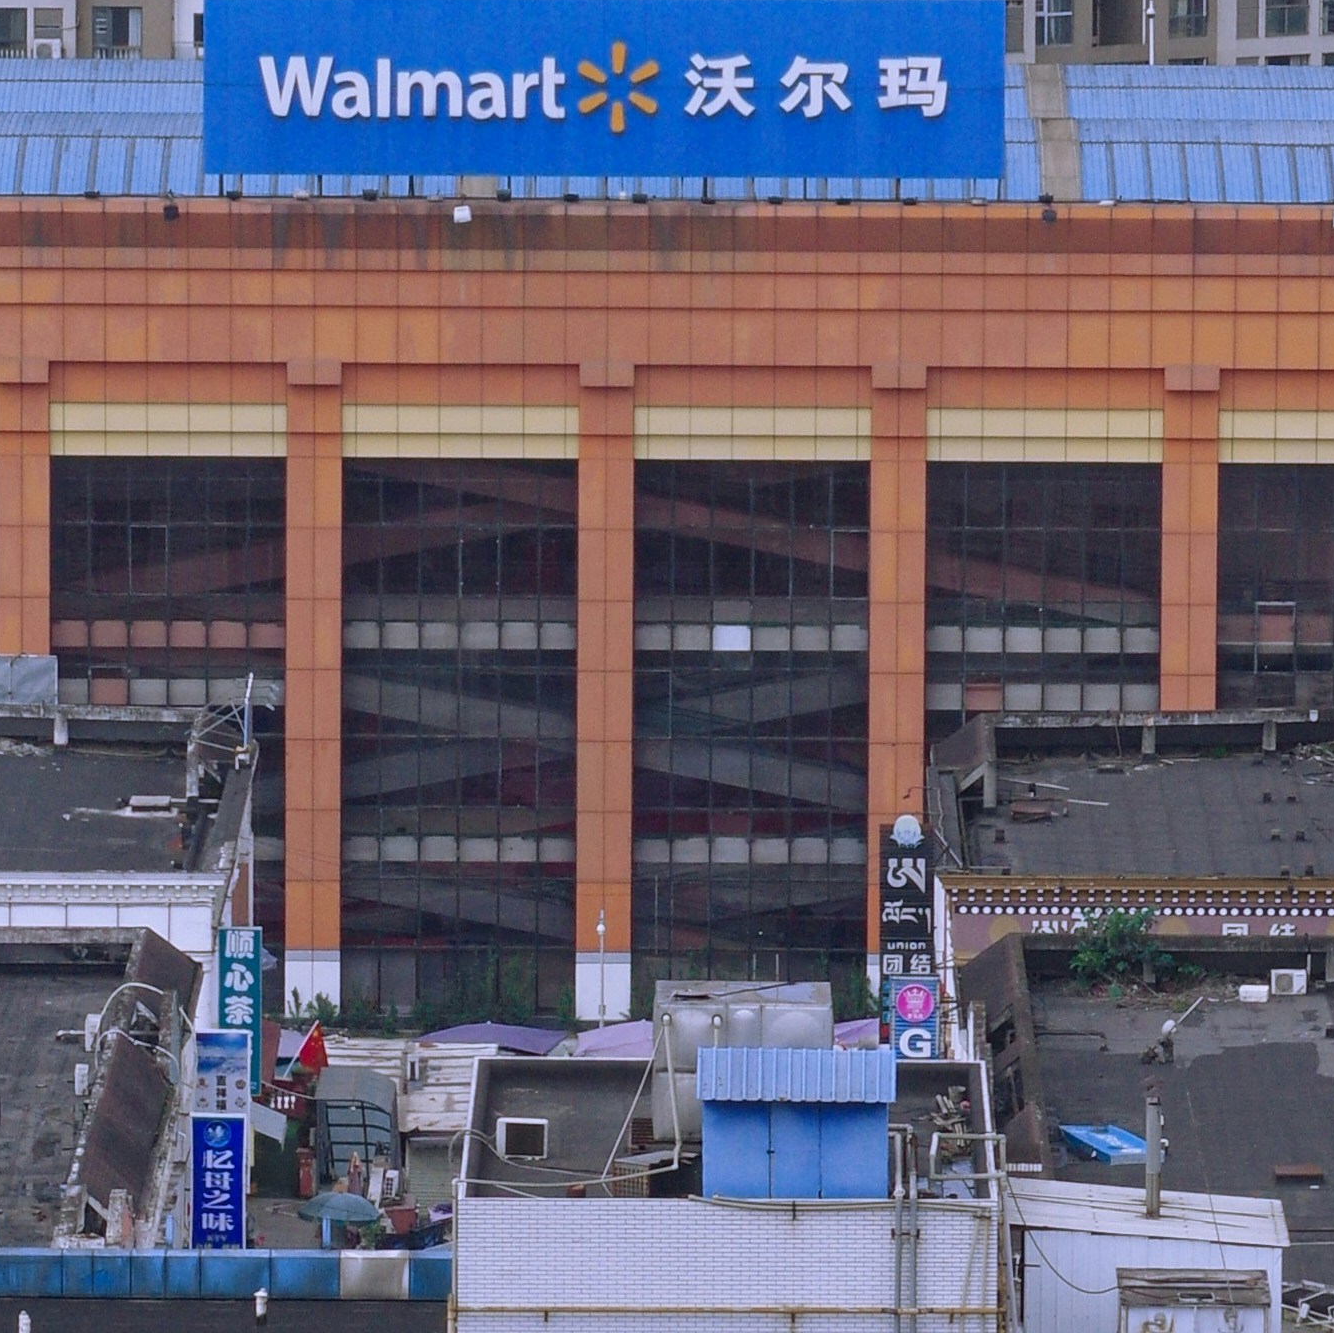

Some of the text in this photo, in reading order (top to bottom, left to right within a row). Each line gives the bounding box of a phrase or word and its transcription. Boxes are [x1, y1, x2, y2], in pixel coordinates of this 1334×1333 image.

[259, 55, 565, 120] Walmart
[684, 53, 947, 118] 沃尔玛
[882, 953, 931, 975] 团结
[887, 941, 926, 950] union
[202, 1150, 235, 1232] 忆母之味
